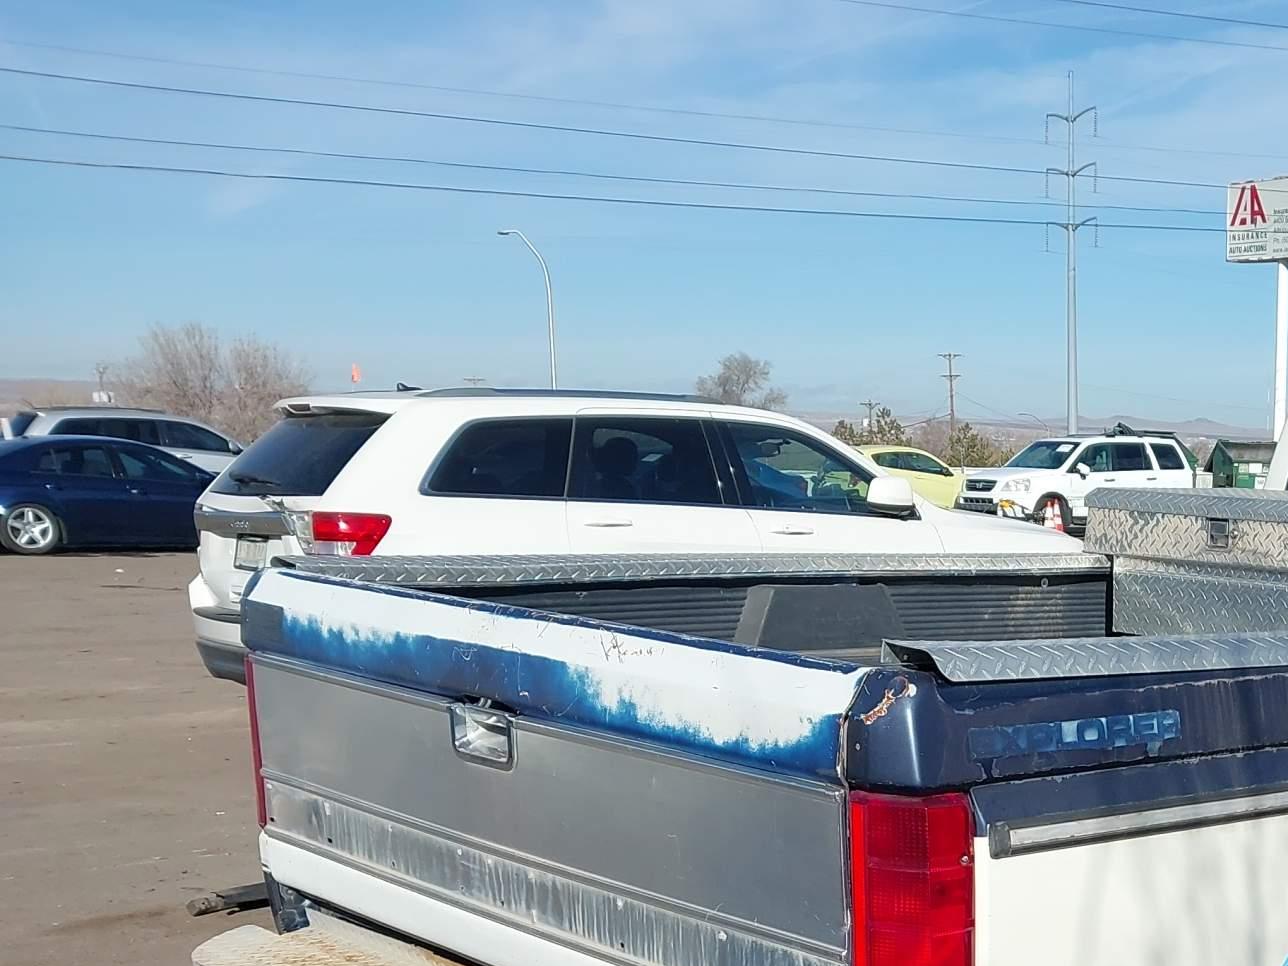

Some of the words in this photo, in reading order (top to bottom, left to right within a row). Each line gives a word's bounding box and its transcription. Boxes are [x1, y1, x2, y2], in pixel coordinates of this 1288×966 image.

[1229, 231, 1268, 242] INSURANCE
[1229, 246, 1242, 255] AUTO
[1243, 243, 1268, 253] AUCTIONS
